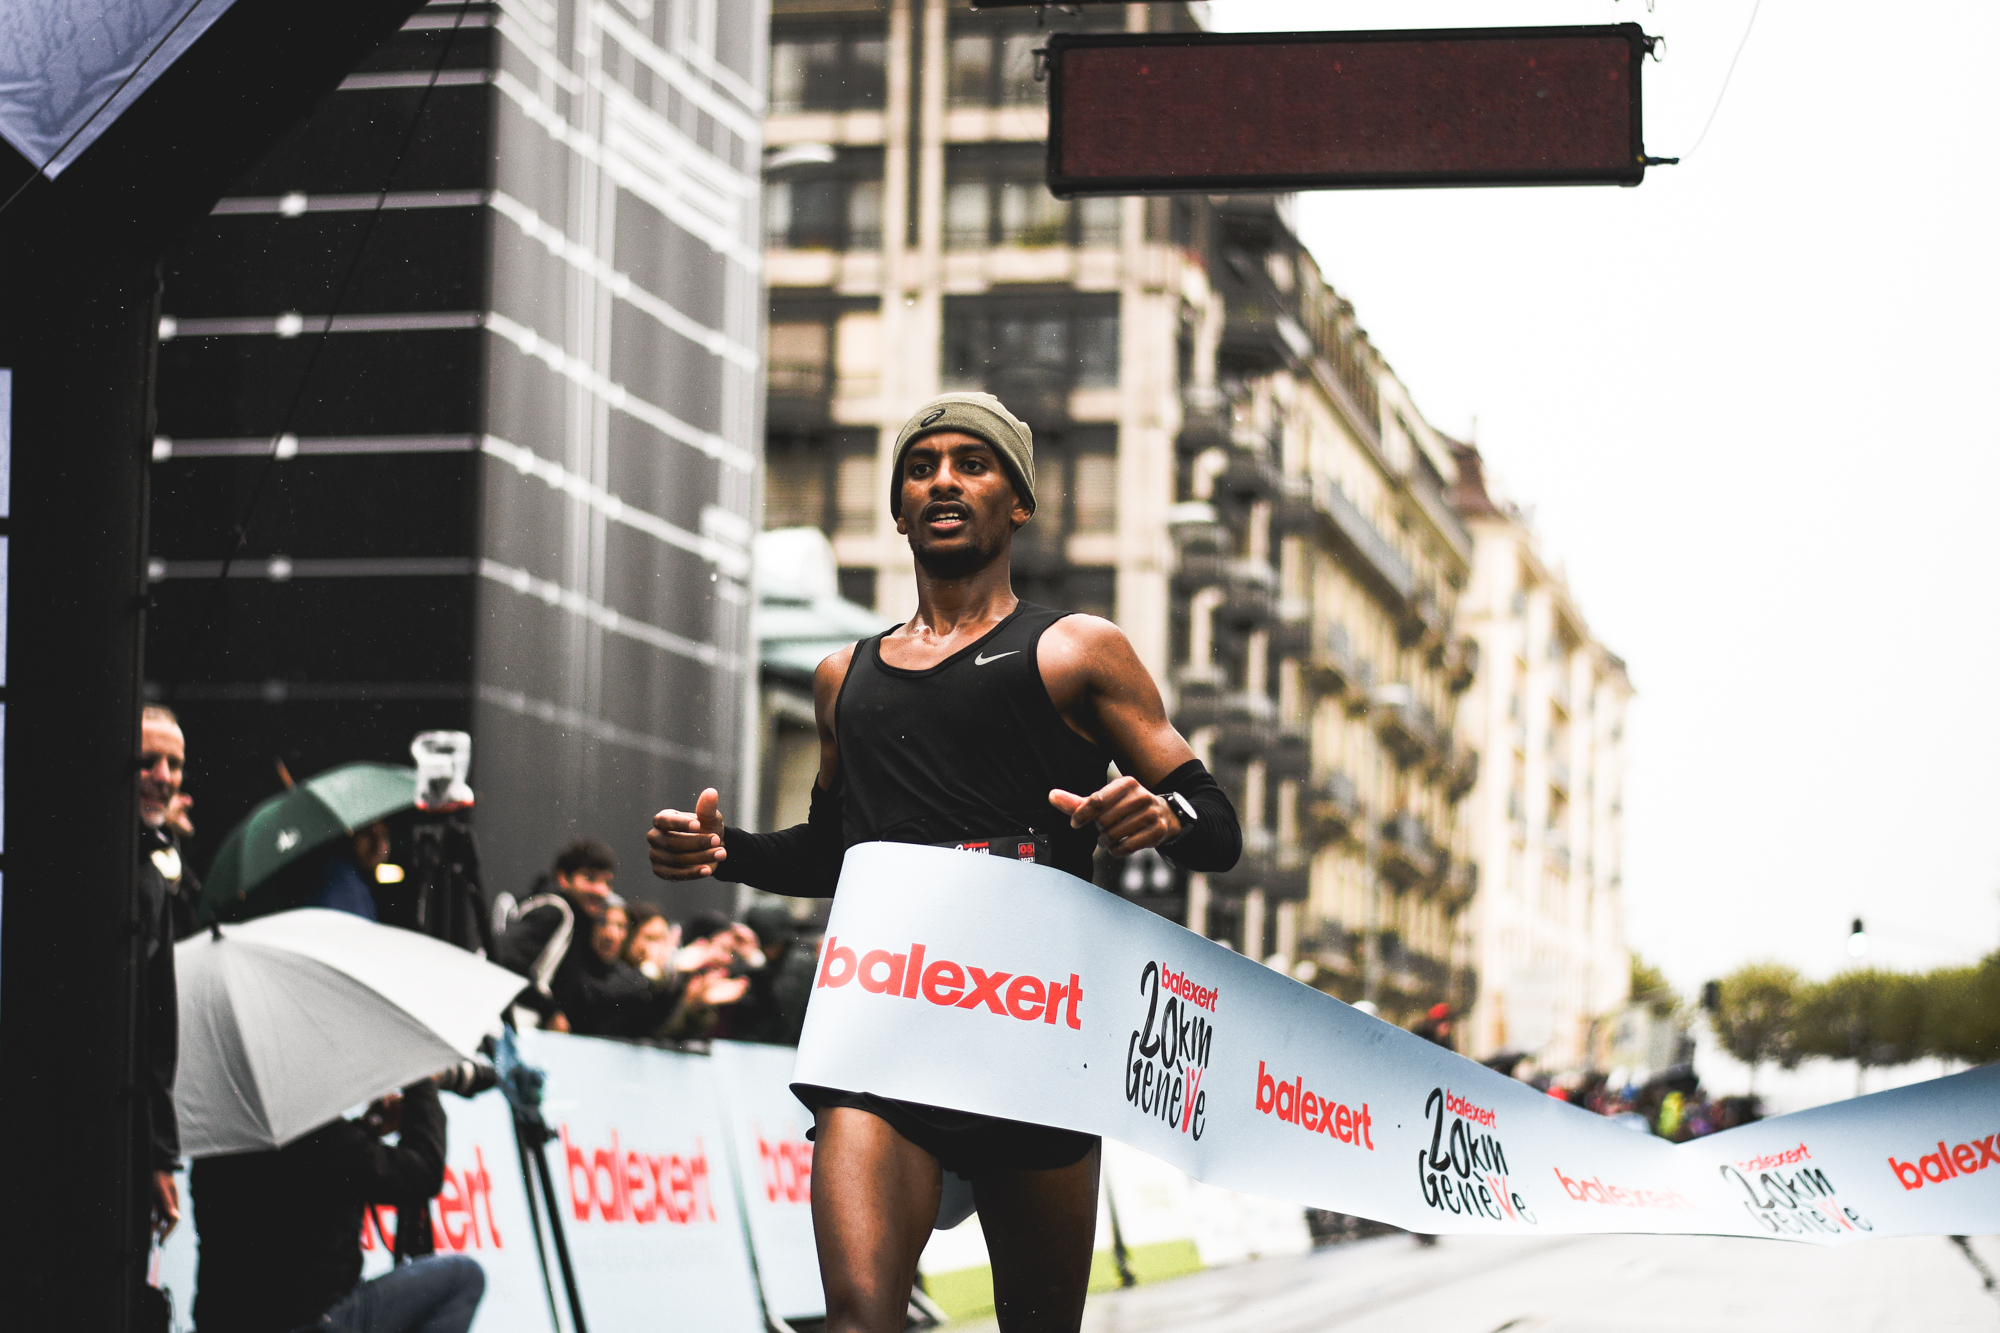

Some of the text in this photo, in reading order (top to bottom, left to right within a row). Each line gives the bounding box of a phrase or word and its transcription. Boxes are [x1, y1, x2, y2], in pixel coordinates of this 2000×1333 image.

[816, 935, 1084, 1031] balexert
[1161, 962, 1219, 1013] balexert
[1138, 960, 1213, 1069] 20km
[1255, 1060, 1375, 1151] balexert
[1424, 1086, 1510, 1180] 20km
[1445, 1088, 1497, 1130] balexert
[562, 1123, 717, 1225] balexert
[1719, 1164, 1836, 1209] 20km
[1735, 1142, 1812, 1173] balexert
[1887, 1132, 2000, 1191] balex
[1553, 1166, 1699, 1210] balexert
